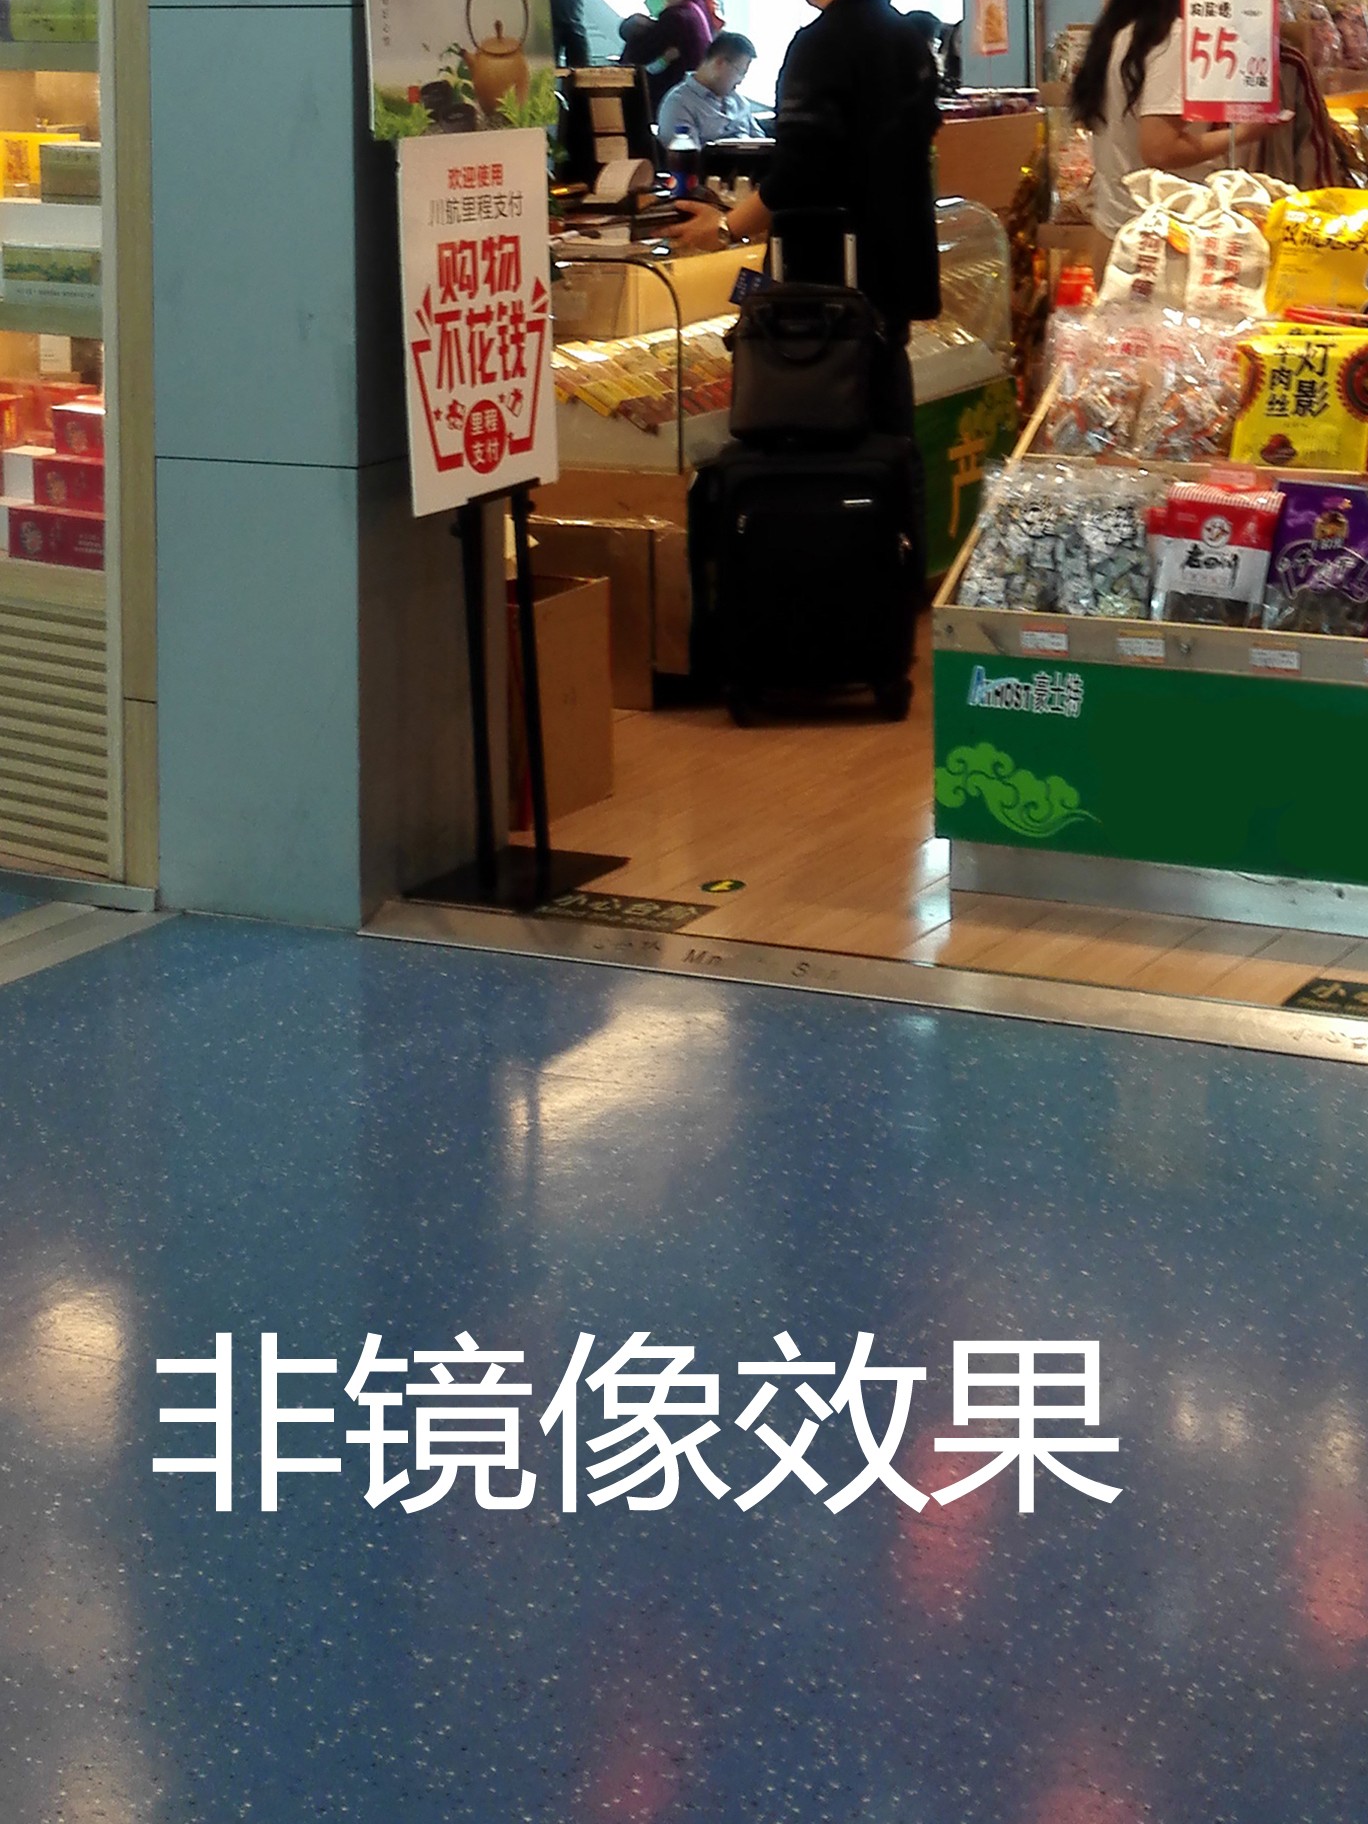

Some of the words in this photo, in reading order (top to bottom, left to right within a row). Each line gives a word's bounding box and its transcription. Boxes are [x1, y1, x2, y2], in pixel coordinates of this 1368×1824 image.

[448, 163, 504, 189] 欢迎使用
[437, 235, 521, 304] 购物
[434, 301, 527, 393] 不花钱
[1294, 341, 1337, 418] 灯影
[469, 410, 498, 436] 里程
[471, 438, 500, 466] 支付
